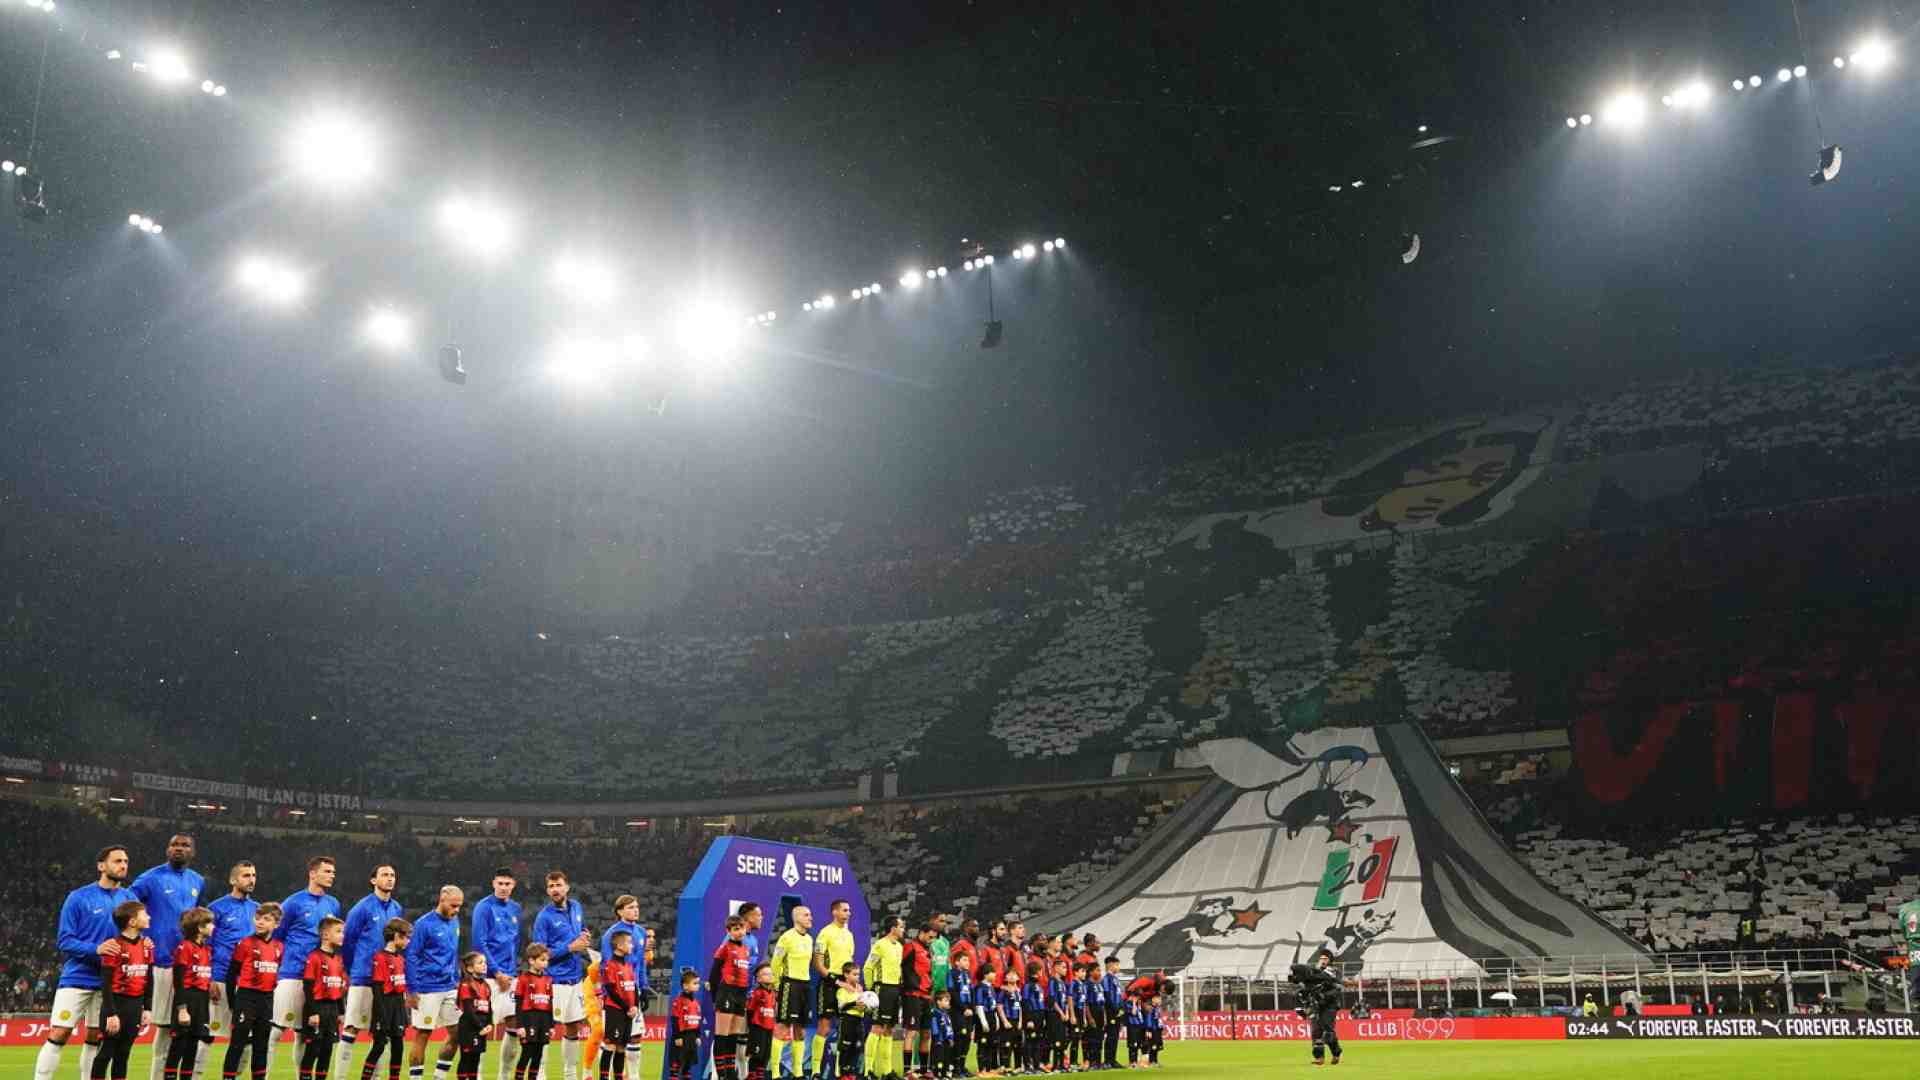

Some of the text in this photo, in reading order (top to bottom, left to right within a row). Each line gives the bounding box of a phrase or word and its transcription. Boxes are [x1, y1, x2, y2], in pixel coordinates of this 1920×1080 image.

[737, 854, 776, 877] SERIE
[819, 864, 843, 885] TIM
[1328, 854, 1381, 895] 20
[1243, 1024, 1260, 1038] AT
[1263, 1024, 1293, 1038] SAN
[1296, 1024, 1312, 1038] SI
[1358, 1022, 1397, 1037] CLUB
[1568, 1018, 1919, 1036] 02:44 FOREVER. FASTER. FOREVER. FASTER.
